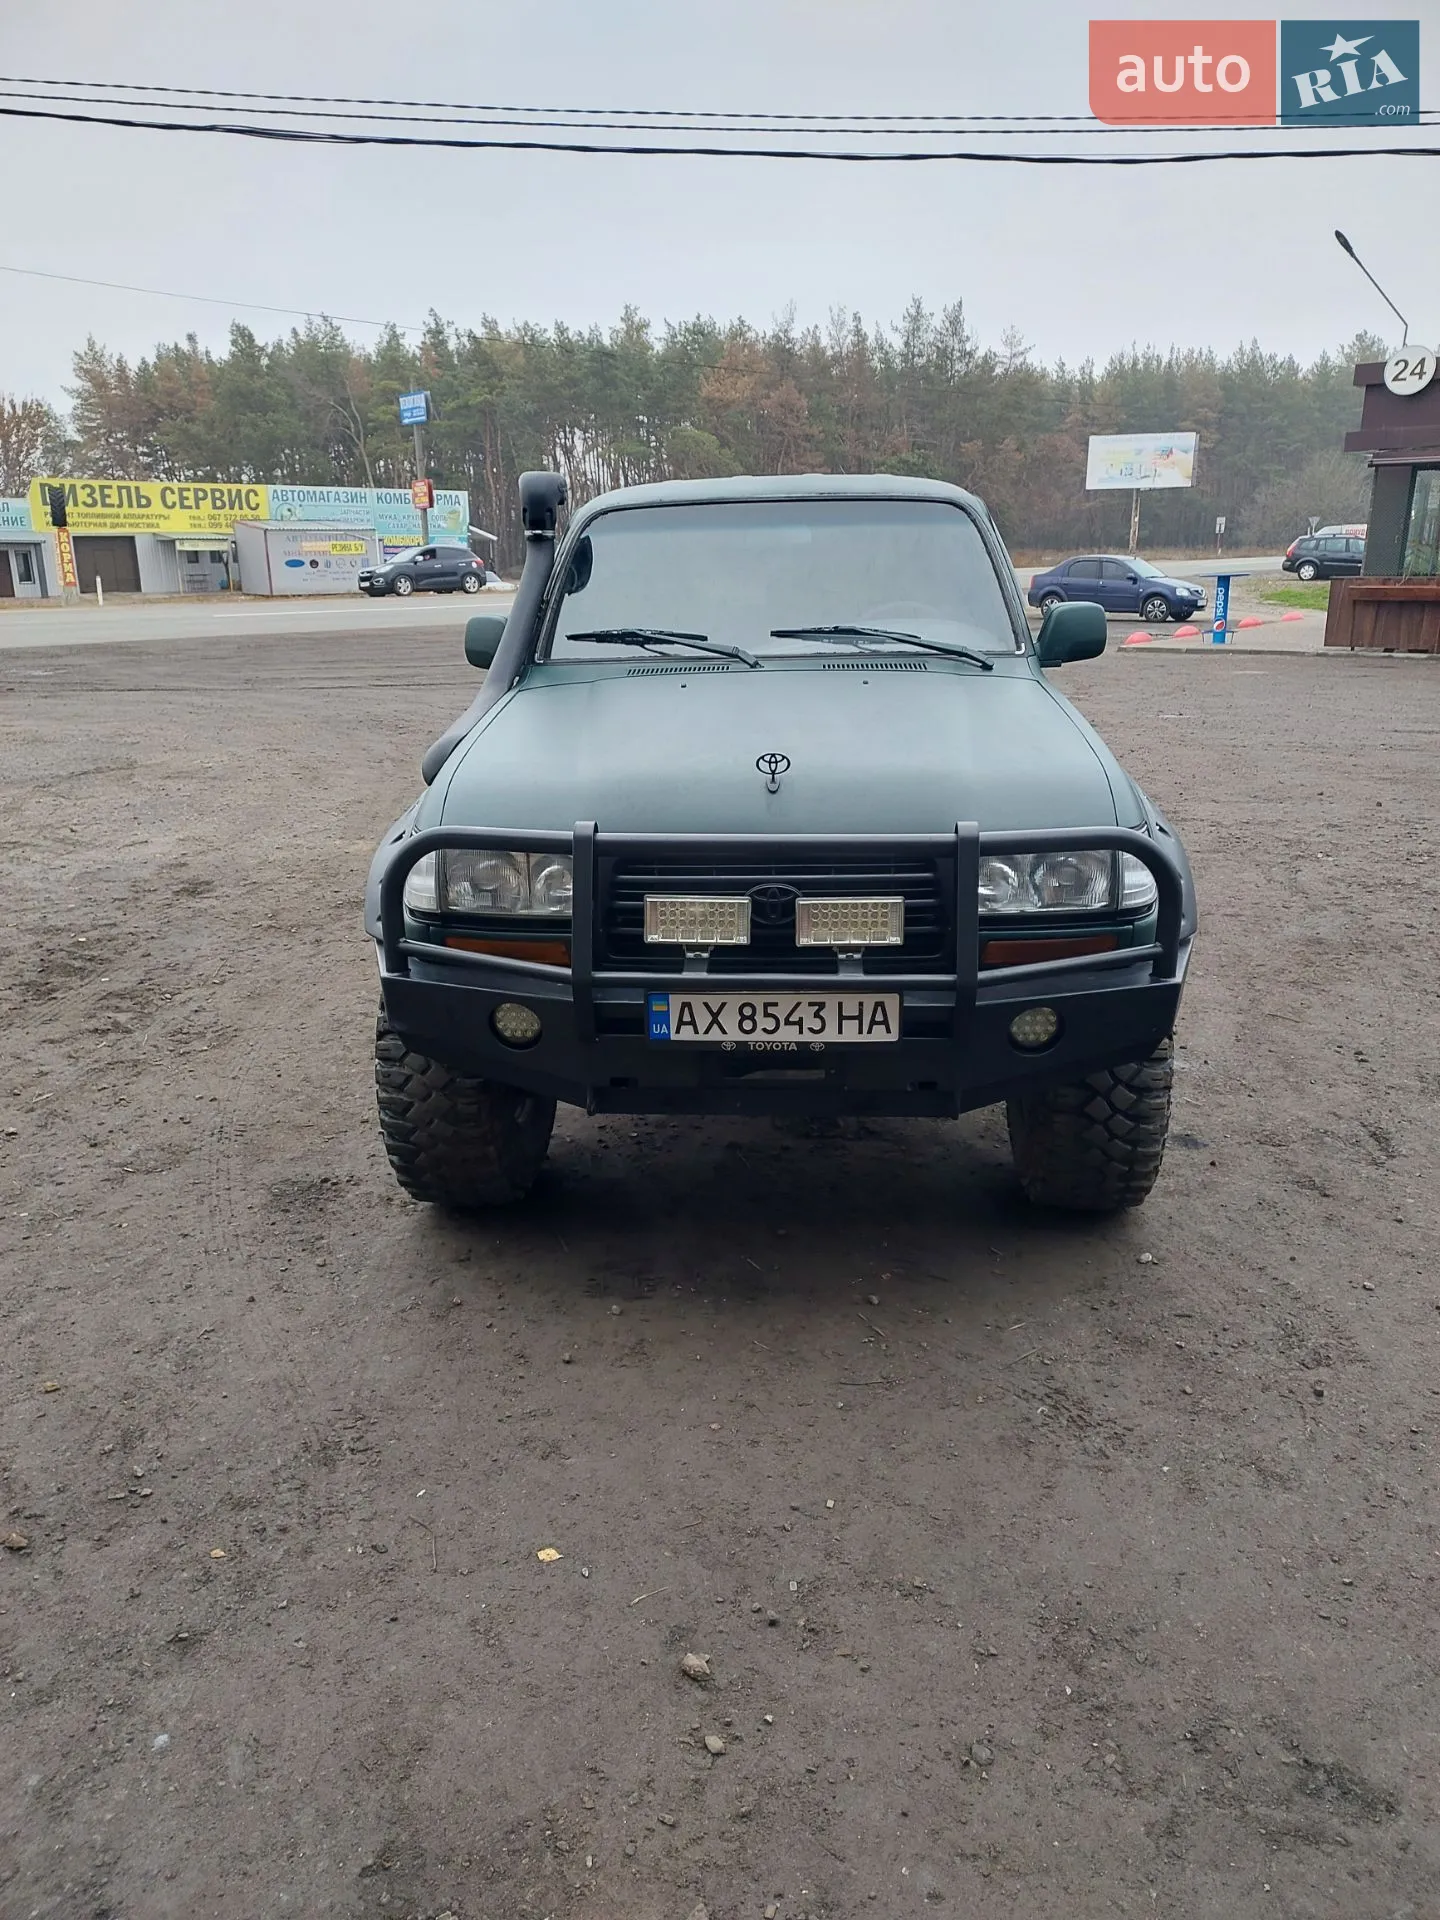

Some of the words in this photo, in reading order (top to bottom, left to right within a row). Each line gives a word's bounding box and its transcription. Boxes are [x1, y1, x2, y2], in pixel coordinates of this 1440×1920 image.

[1391, 356, 1427, 382] 24
[160, 486, 260, 511] СЕРВИС
[271, 489, 368, 504] АВТОМАГАЗИН
[376, 492, 462, 506] КОМБРМА
[0, 502, 10, 513] Л
[0, 516, 27, 527] НИЕ
[59, 532, 76, 583] КОРМА
[1215, 587, 1225, 618] pepsi
[674, 1001, 728, 1035] AX
[737, 1001, 827, 1035] 8543
[837, 1001, 892, 1035] HA
[652, 1023, 669, 1035] UA
[748, 1041, 798, 1051] TOYOTA
